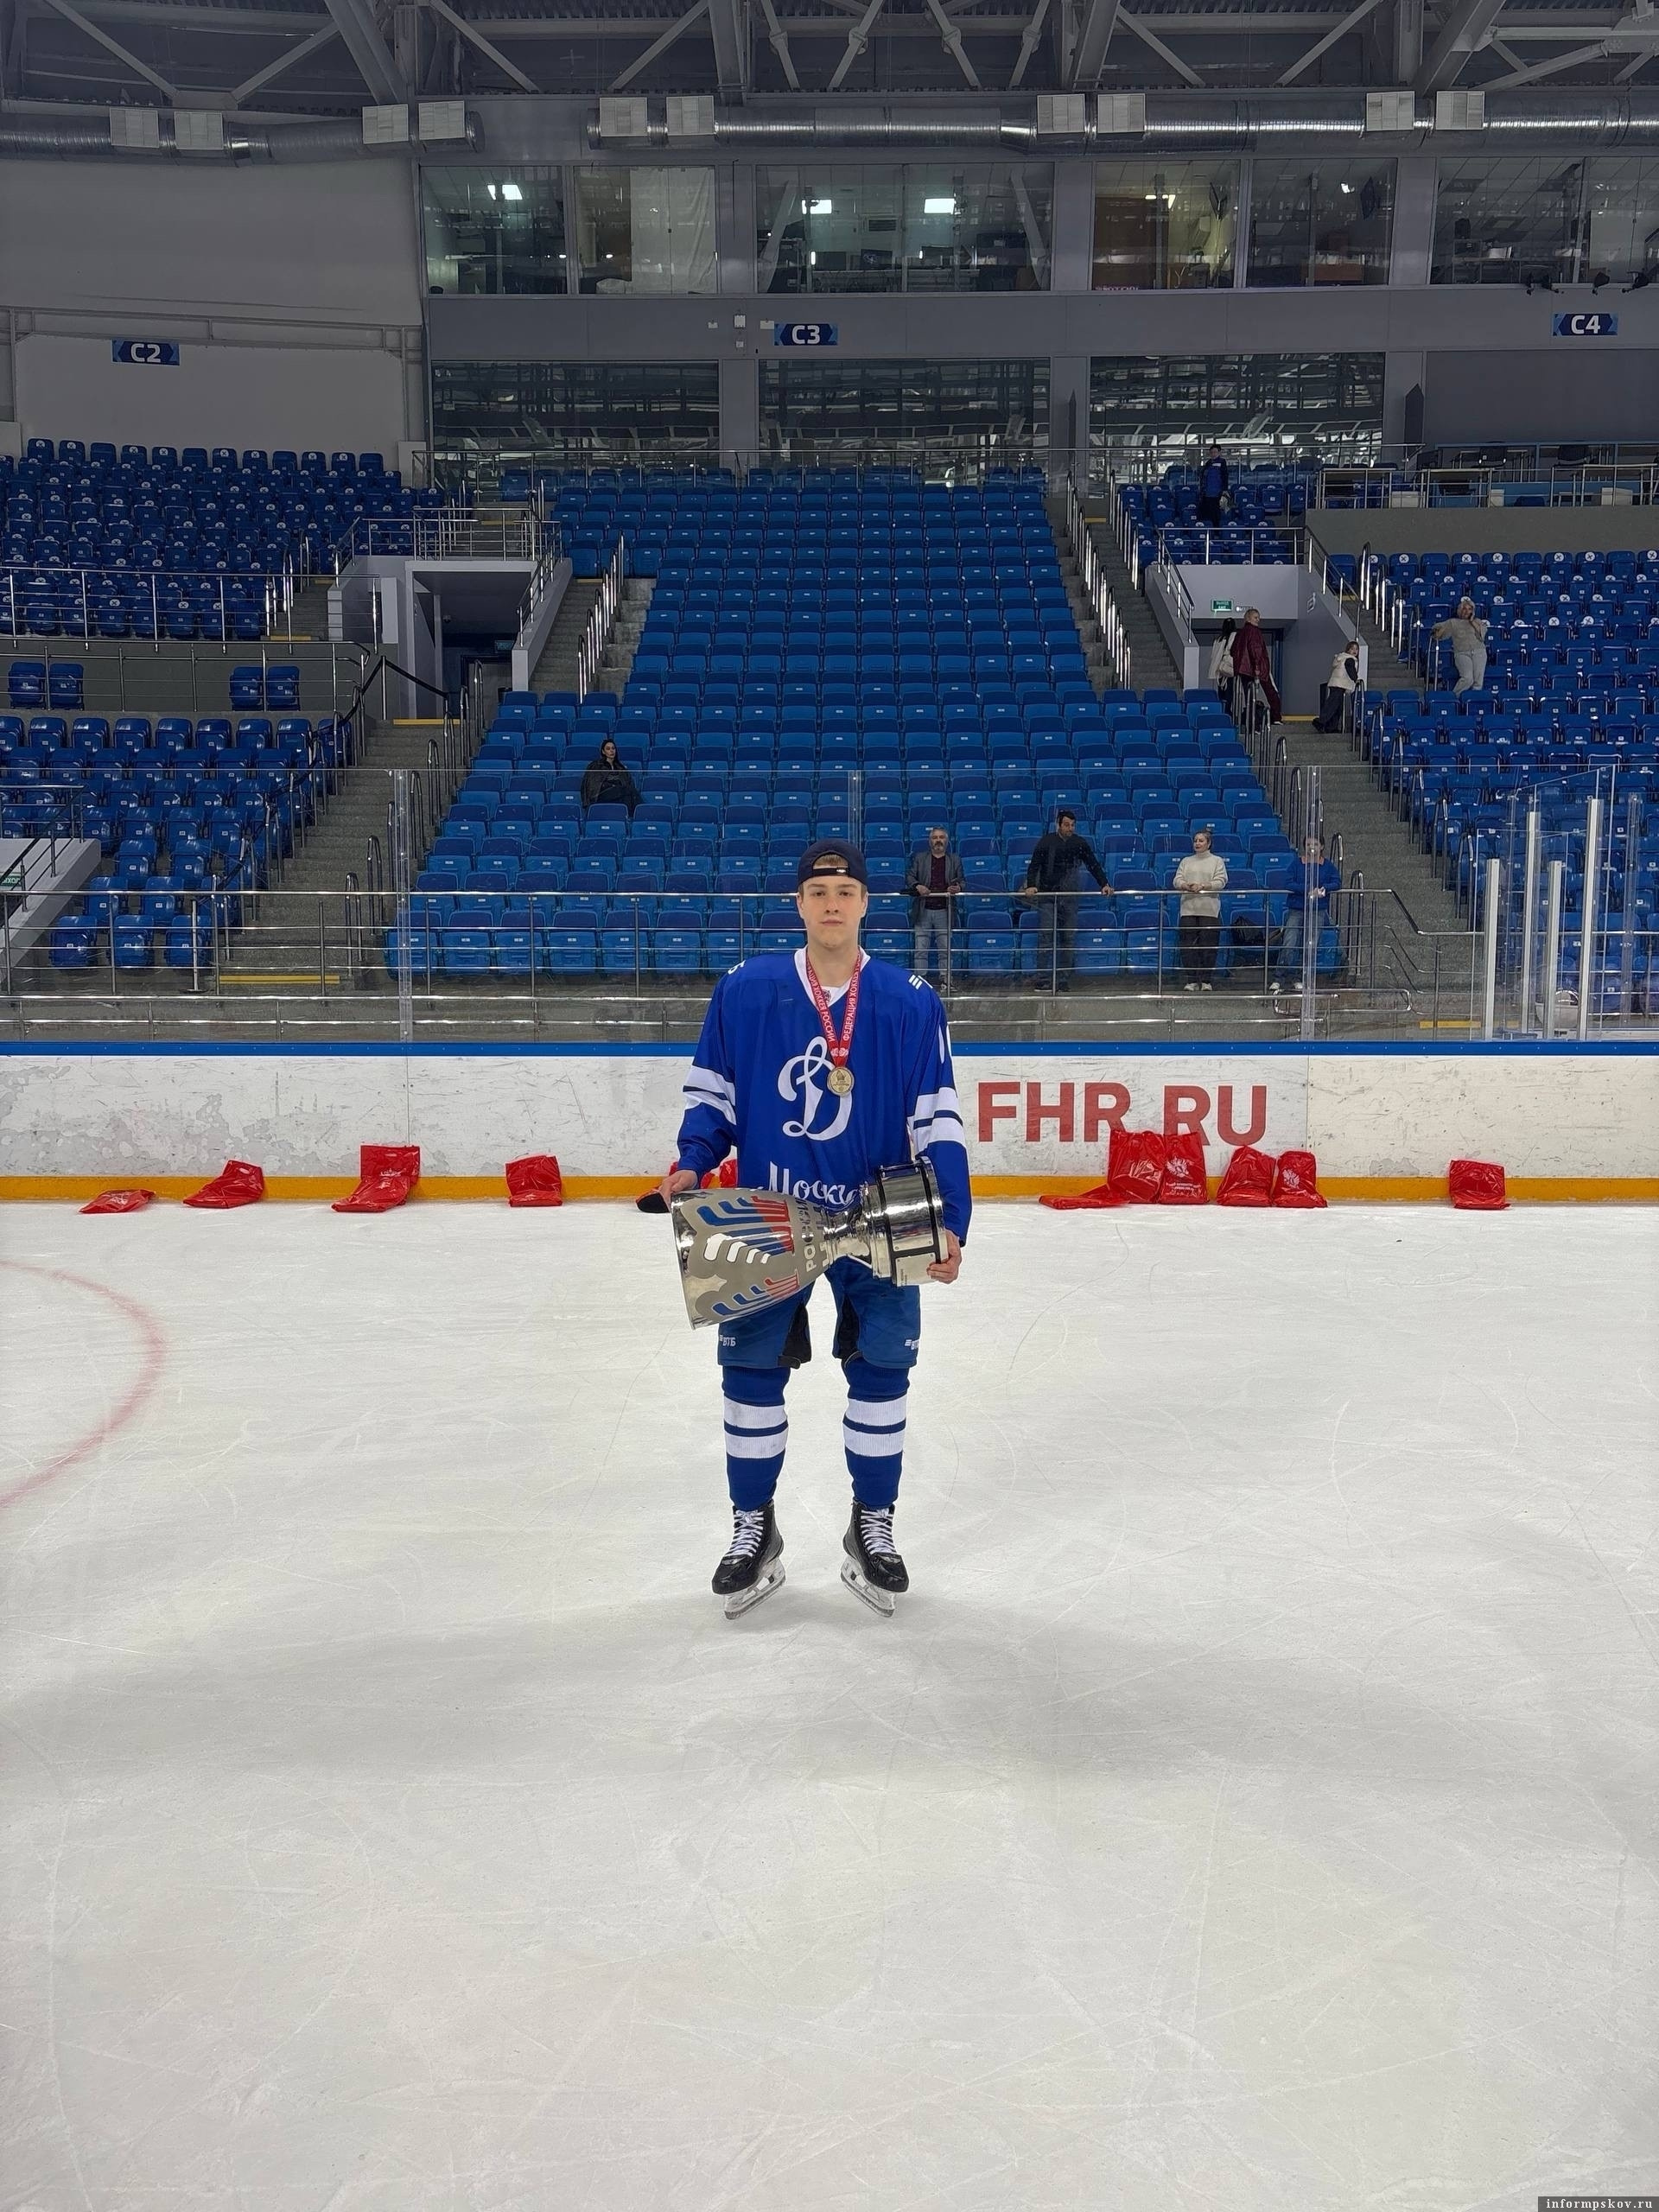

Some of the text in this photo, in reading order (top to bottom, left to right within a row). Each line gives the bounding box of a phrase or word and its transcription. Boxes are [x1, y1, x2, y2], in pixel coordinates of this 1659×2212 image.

[1571, 315, 1601, 334] C4
[791, 325, 821, 345] C3
[130, 343, 162, 363] C2
[813, 986, 827, 1011] ХОККЕЯ
[822, 1010, 836, 1042] РОССИИ
[722, 1337, 736, 1347] ВТБ
